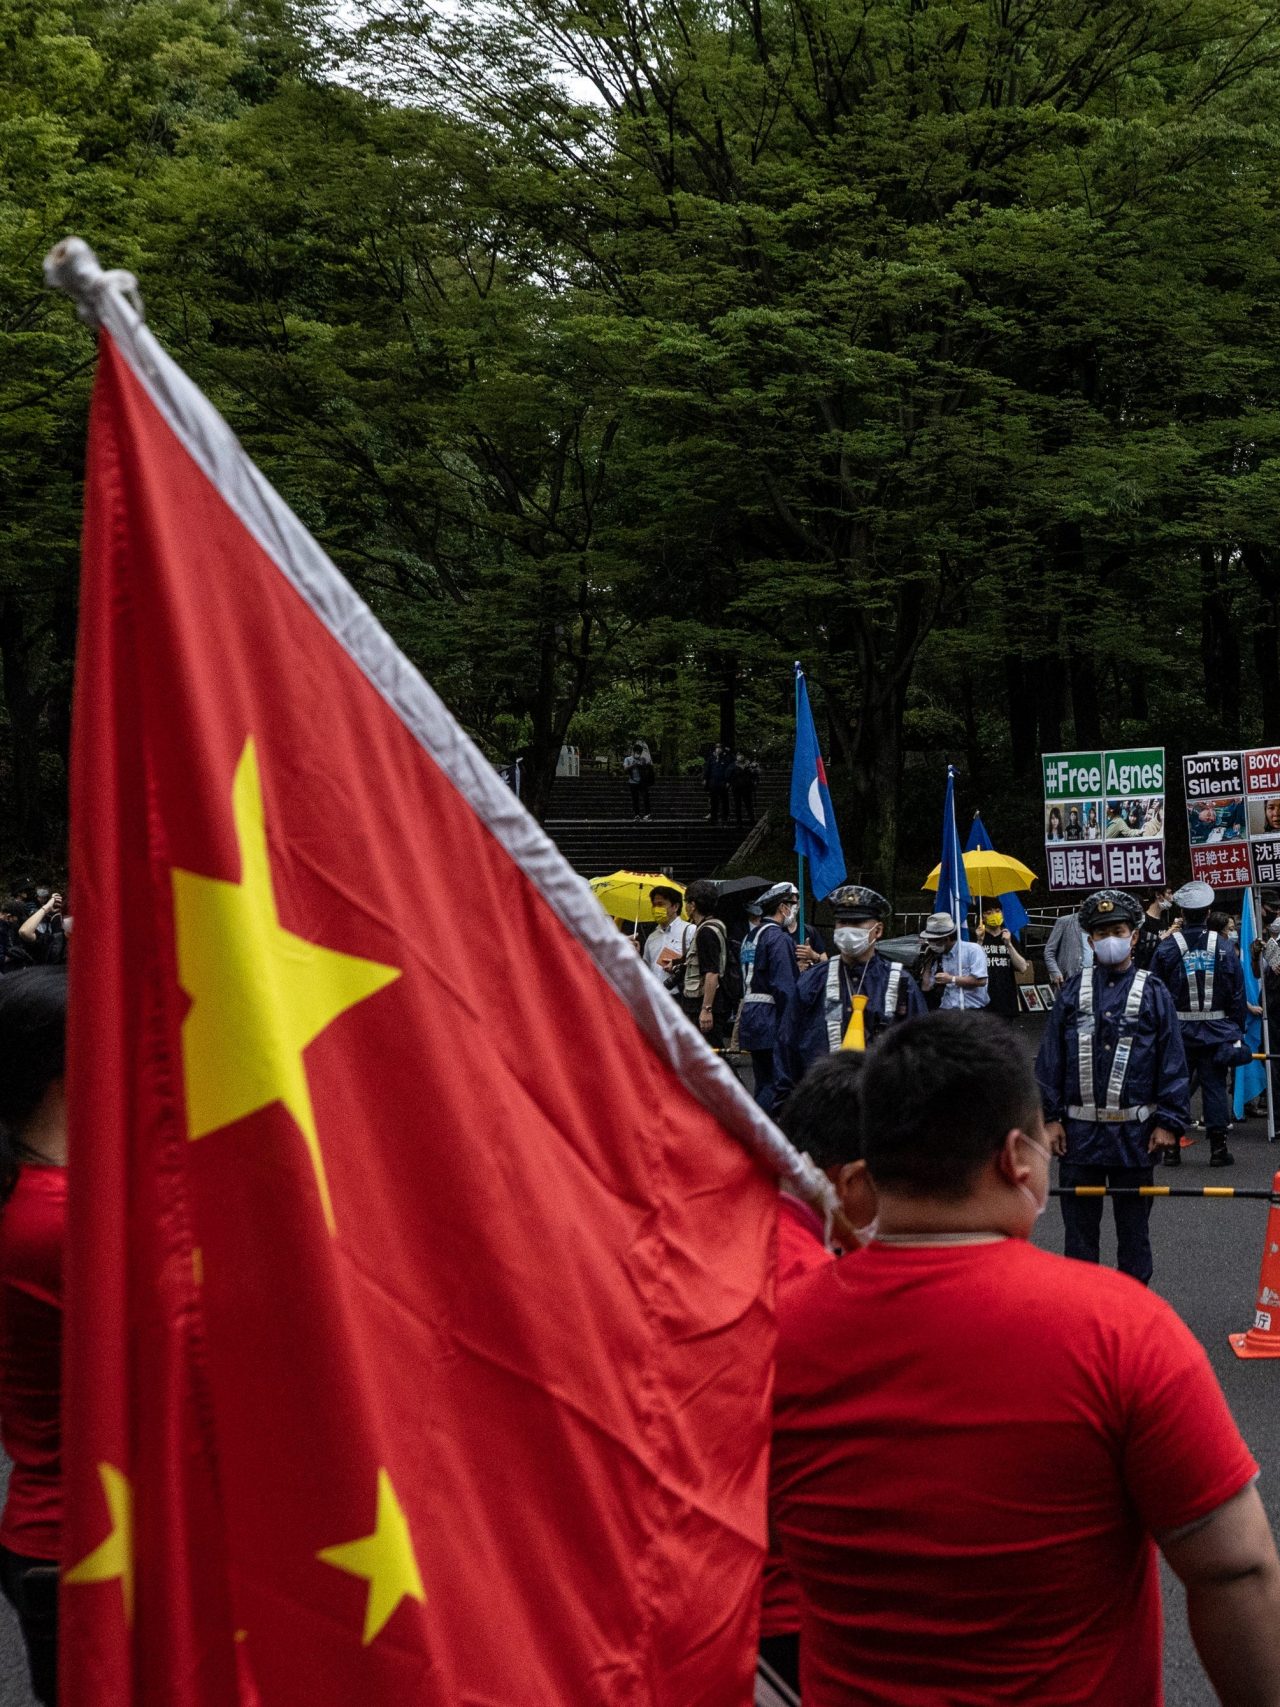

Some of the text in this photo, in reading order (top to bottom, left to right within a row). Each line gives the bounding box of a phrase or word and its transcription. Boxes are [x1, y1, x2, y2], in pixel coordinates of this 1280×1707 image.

[1187, 756, 1238, 775] Don't Be
[1046, 758, 1163, 794] #Free Agnes
[1188, 776, 1241, 796] Silent
